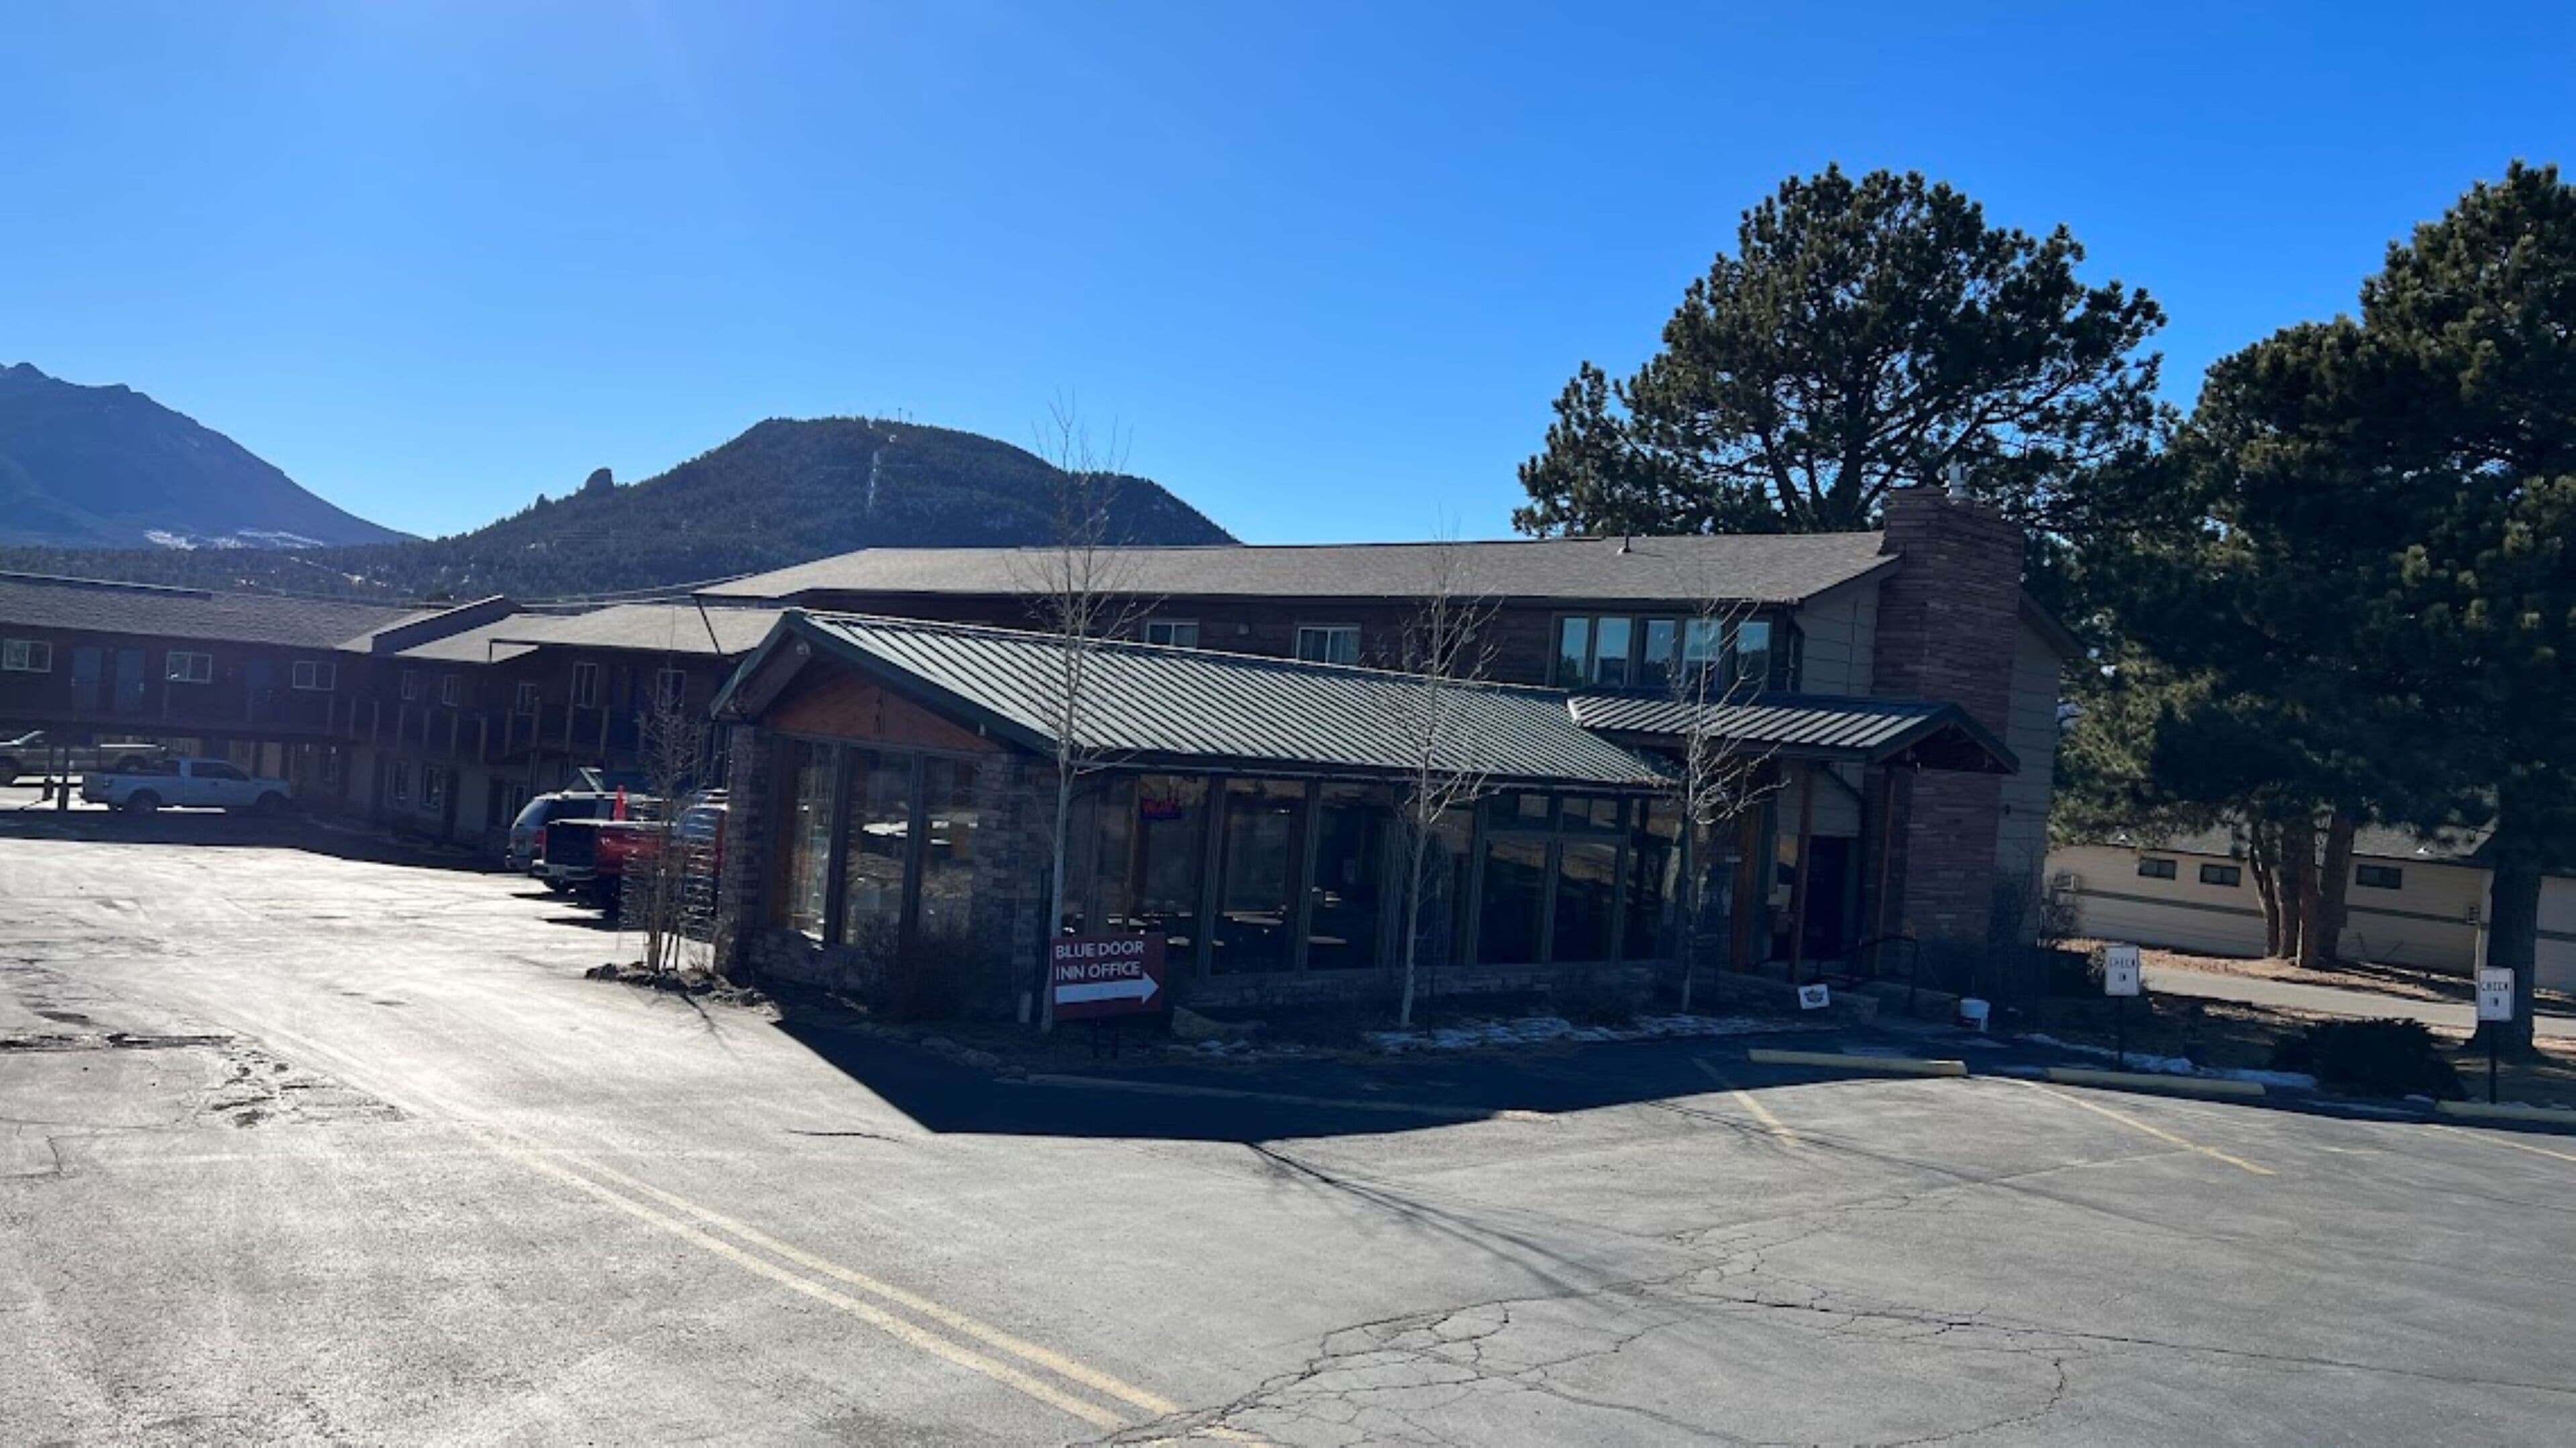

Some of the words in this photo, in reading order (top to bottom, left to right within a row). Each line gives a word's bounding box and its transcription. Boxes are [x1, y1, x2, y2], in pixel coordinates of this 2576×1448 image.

[1055, 943, 1095, 960] BLUE
[1098, 940, 1144, 956] DOOR
[1055, 965, 1085, 980] INN
[1087, 961, 1142, 978] OFFICE
